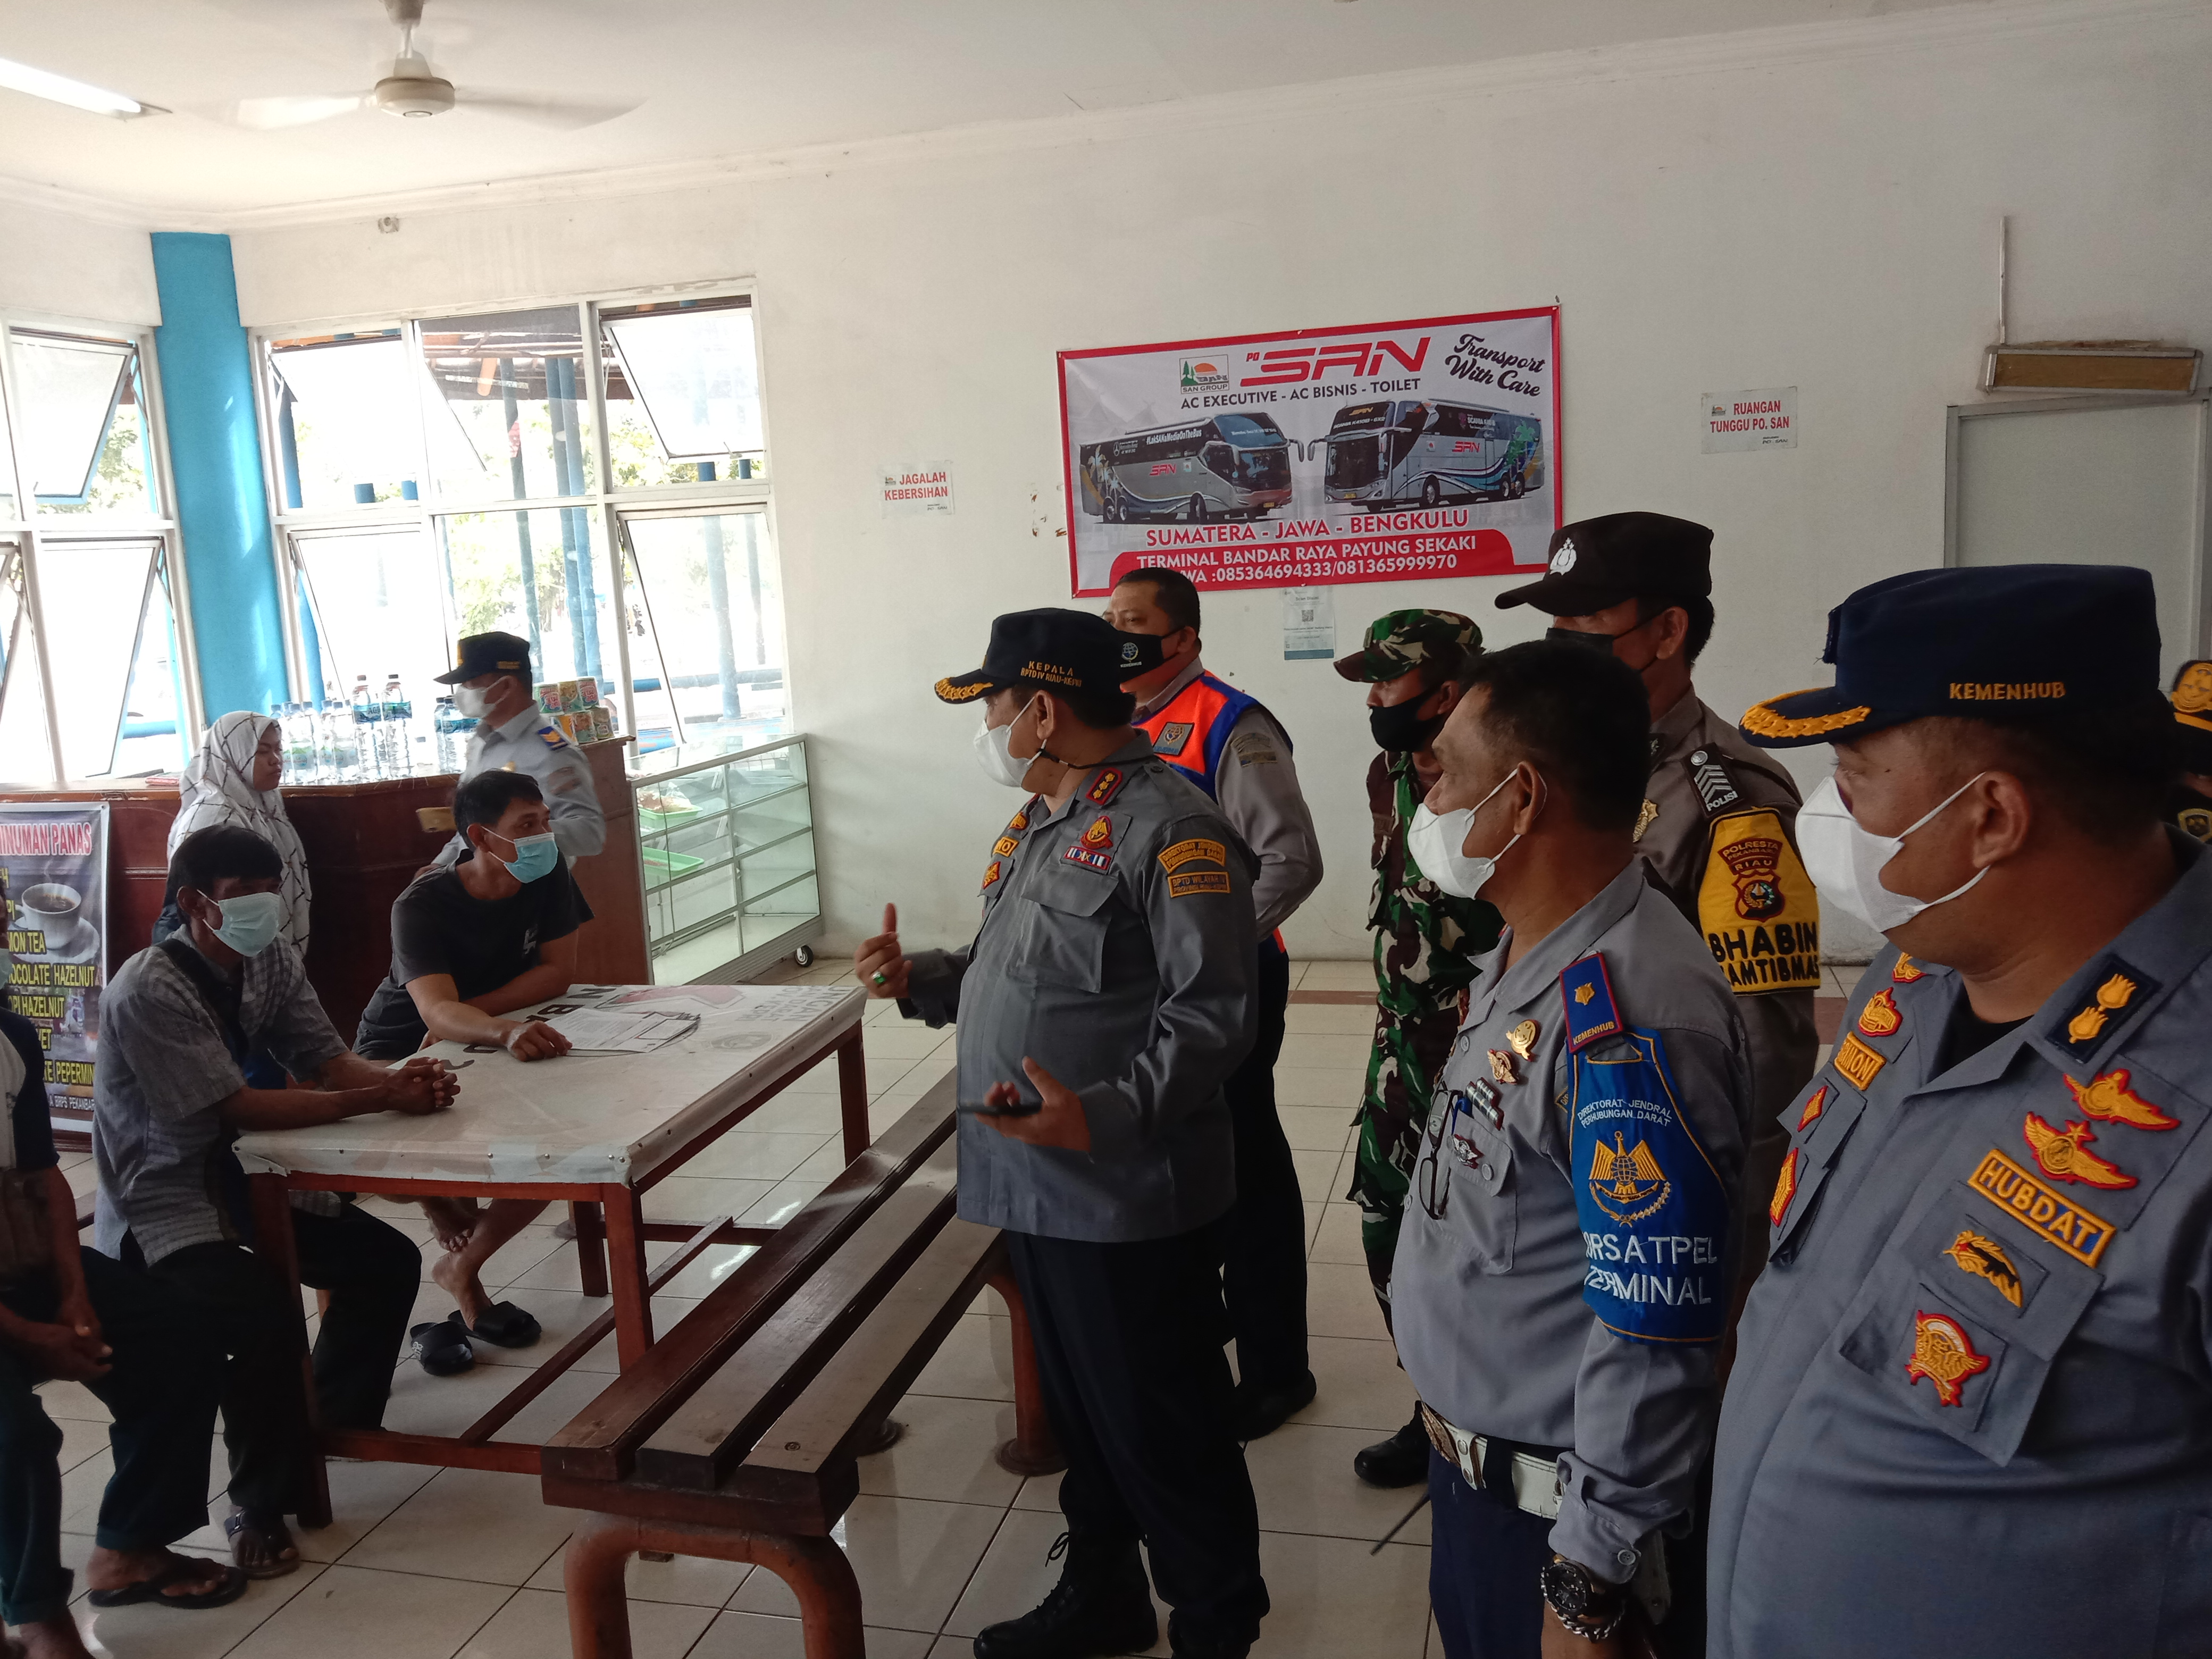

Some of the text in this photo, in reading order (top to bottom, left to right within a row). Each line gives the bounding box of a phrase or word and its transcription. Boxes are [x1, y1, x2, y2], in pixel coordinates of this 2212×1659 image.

[1240, 337, 1431, 387] PO SAN
[1453, 333, 1546, 373] Transport
[1445, 355, 1541, 397] With Care
[1180, 396, 1200, 409] AC
[1204, 390, 1277, 408] EXECUTIVE
[1289, 388, 1309, 401] AC
[1314, 382, 1358, 398] BISNIS
[1370, 378, 1421, 393] TOILET
[1733, 400, 1781, 415] RUANGAN
[1710, 416, 1790, 433] TUNGGU PO. SAN
[1452, 440, 1480, 453] SAN
[899, 472, 946, 485] JAGALAH
[1149, 463, 1177, 476] SAN
[884, 486, 948, 501] KEBERSIHAN
[1146, 522, 1257, 547] SUMATERA
[1275, 518, 1331, 540] JAWA
[1351, 508, 1470, 533] BENGKULU
[1136, 535, 1477, 569] TERMINAL BANDAR RAYA PAYUNG SEKAKI
[1028, 660, 1074, 677] KEPALA
[1948, 681, 2066, 701] KEMENHUB
[1706, 791, 1739, 812] POLISI
[52, 823, 91, 856] PANAS
[1722, 841, 1779, 858] POLRESTA
[1735, 860, 1773, 871] RIAU
[27, 932, 46, 953] TEA
[1708, 921, 1819, 961] BHABIN
[9, 963, 95, 987] OCOLATE HAZELNUT
[22, 995, 65, 1018] HAZELNUT
[1572, 1021, 1615, 1046] KEMENHUB
[56, 1061, 95, 1085] PEPERMIN
[1577, 1099, 1623, 1120] DIREKTORAT
[1629, 1100, 1672, 1120] JENDRAL
[1581, 1109, 1671, 1129] PERHUBUNGAN DARAT
[1978, 1158, 2100, 1251] HUBDAT
[1582, 1231, 1719, 1265] ORSATPEL
[1583, 1264, 1712, 1306] TERMINAL
